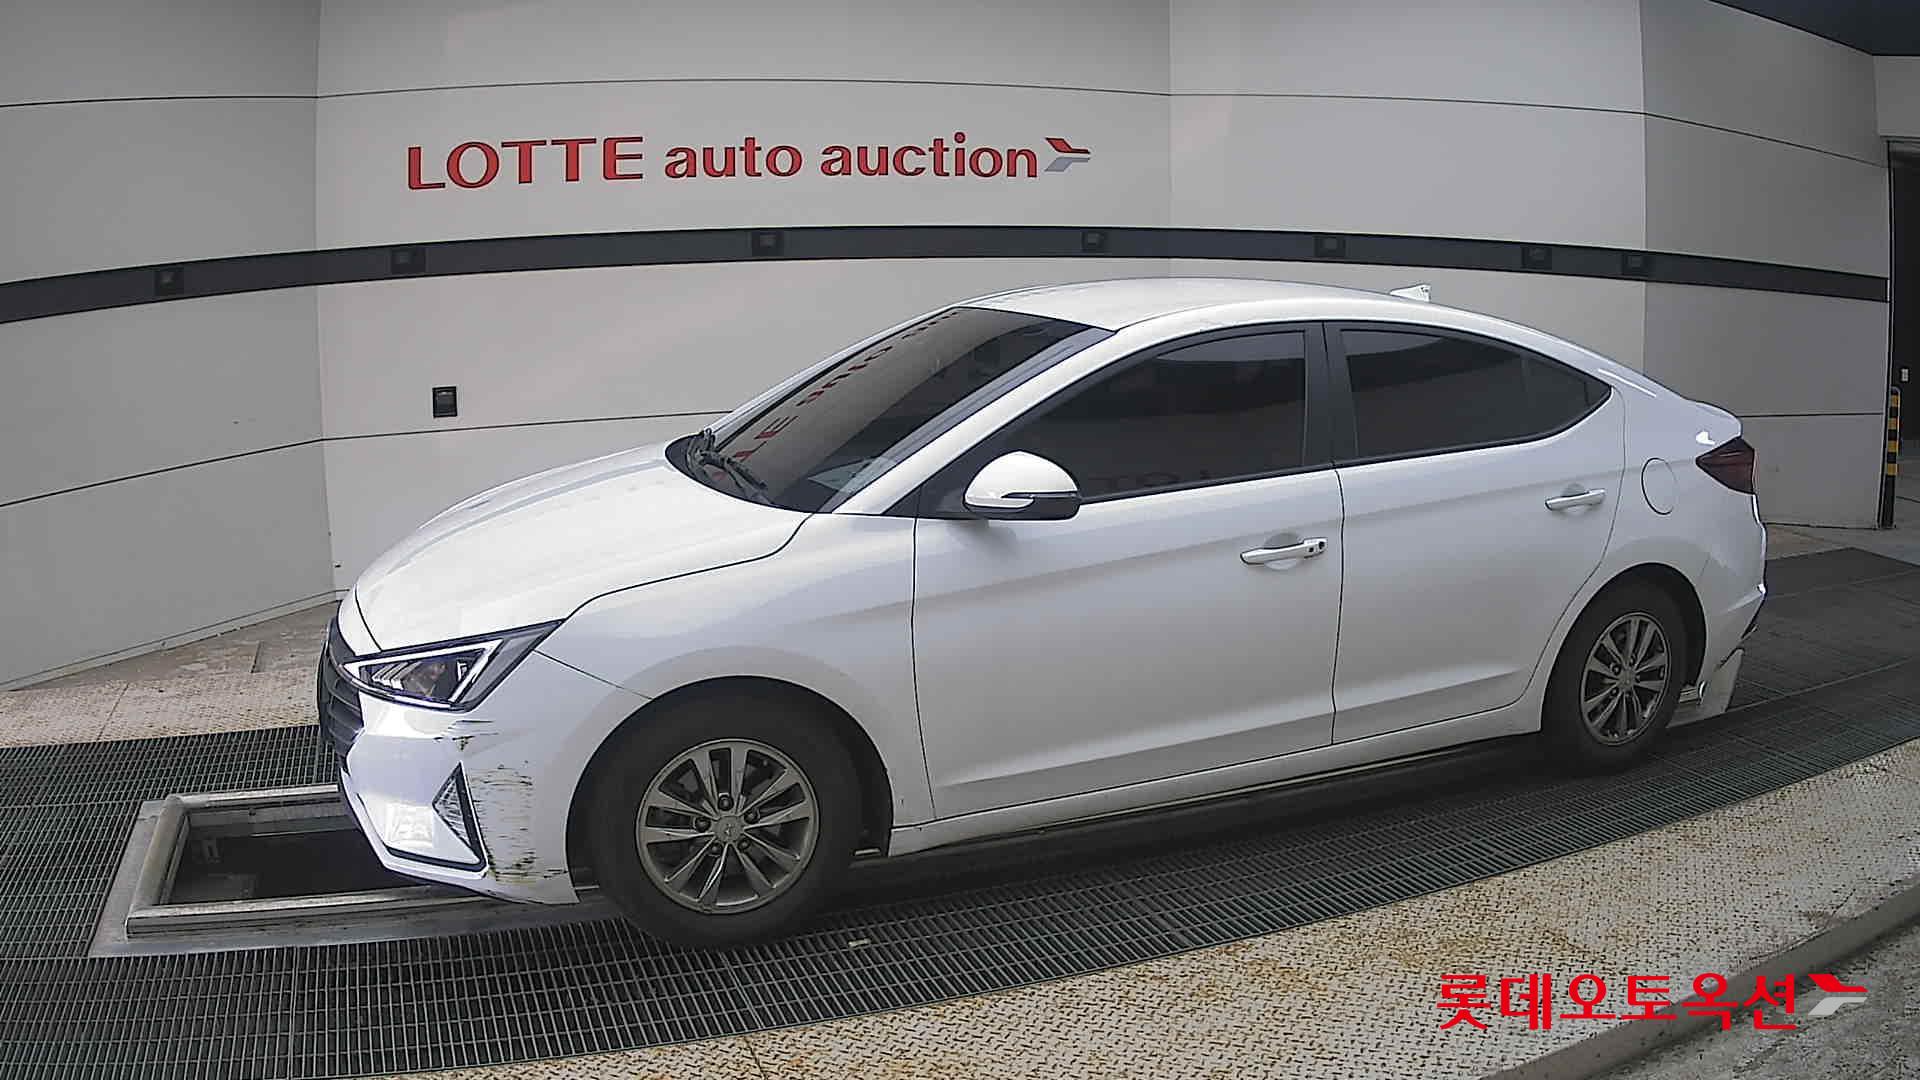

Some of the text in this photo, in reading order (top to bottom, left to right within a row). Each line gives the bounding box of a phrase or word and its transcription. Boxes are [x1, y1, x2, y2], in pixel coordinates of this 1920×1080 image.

[407, 132, 1039, 191] LOTTE auto auction
